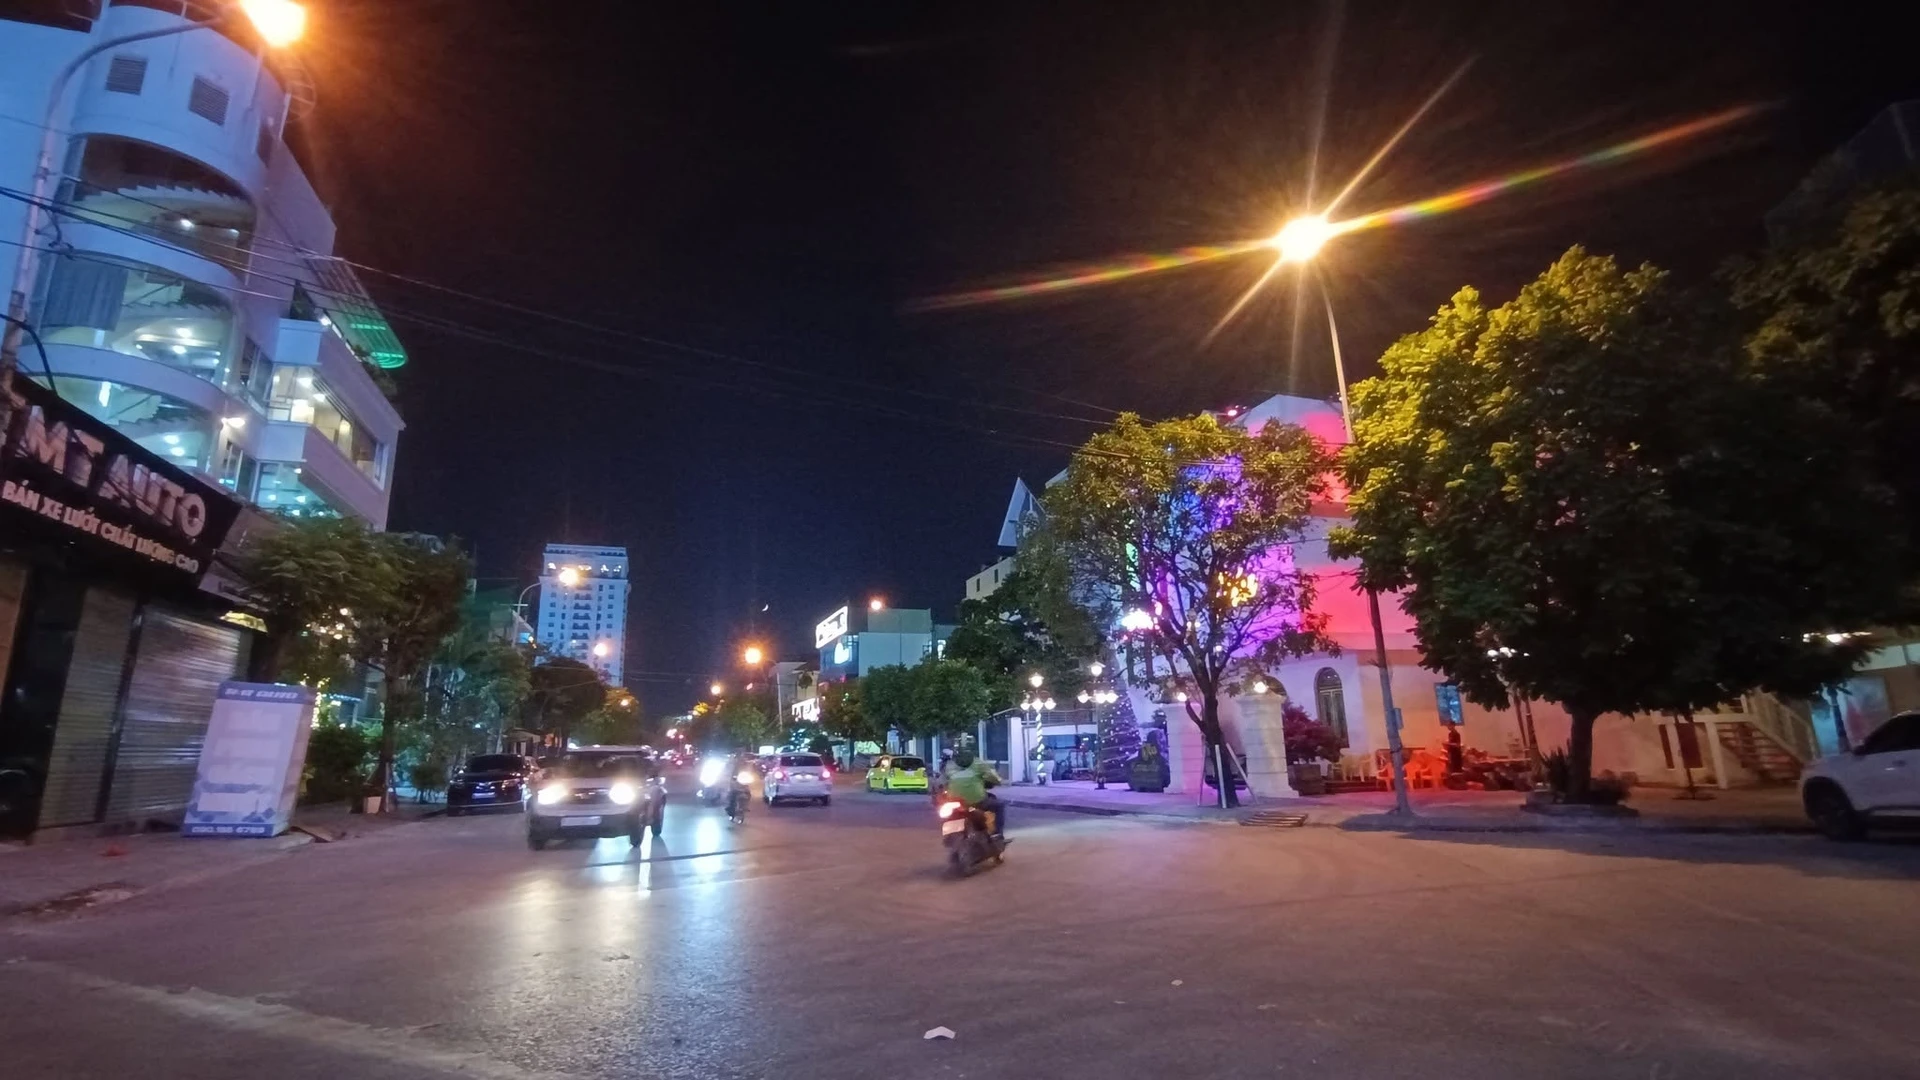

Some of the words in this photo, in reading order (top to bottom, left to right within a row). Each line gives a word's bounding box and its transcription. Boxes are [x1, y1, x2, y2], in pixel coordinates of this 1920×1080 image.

[2, 480, 40, 511] BÁN
[39, 496, 64, 520] XE
[63, 506, 100, 534] LƯỚT
[101, 524, 137, 549] CHẤT
[135, 537, 175, 564] LƯỢNG
[176, 554, 199, 573] CAO
[98, 454, 205, 537] AUTO
